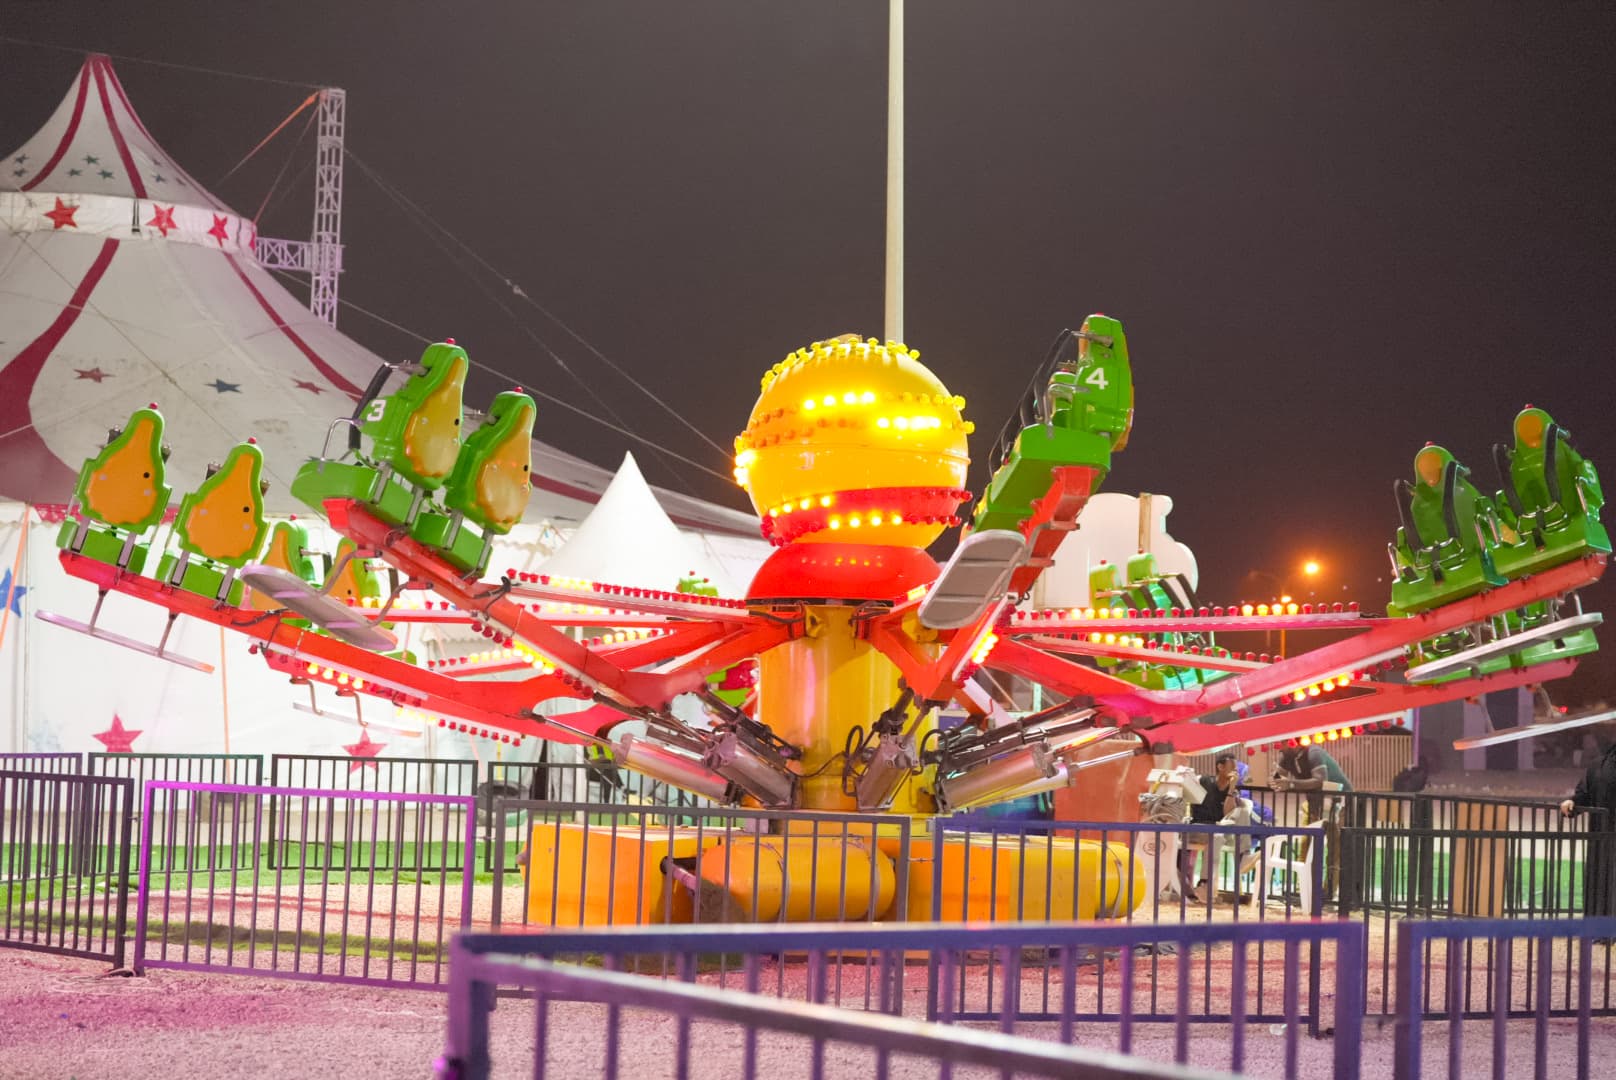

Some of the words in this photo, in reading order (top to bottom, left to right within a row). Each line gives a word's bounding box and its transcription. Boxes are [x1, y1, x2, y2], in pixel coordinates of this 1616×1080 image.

[1085, 367, 1109, 390] 4
[367, 399, 387, 421] 3
[1584, 462, 1597, 484] 5
